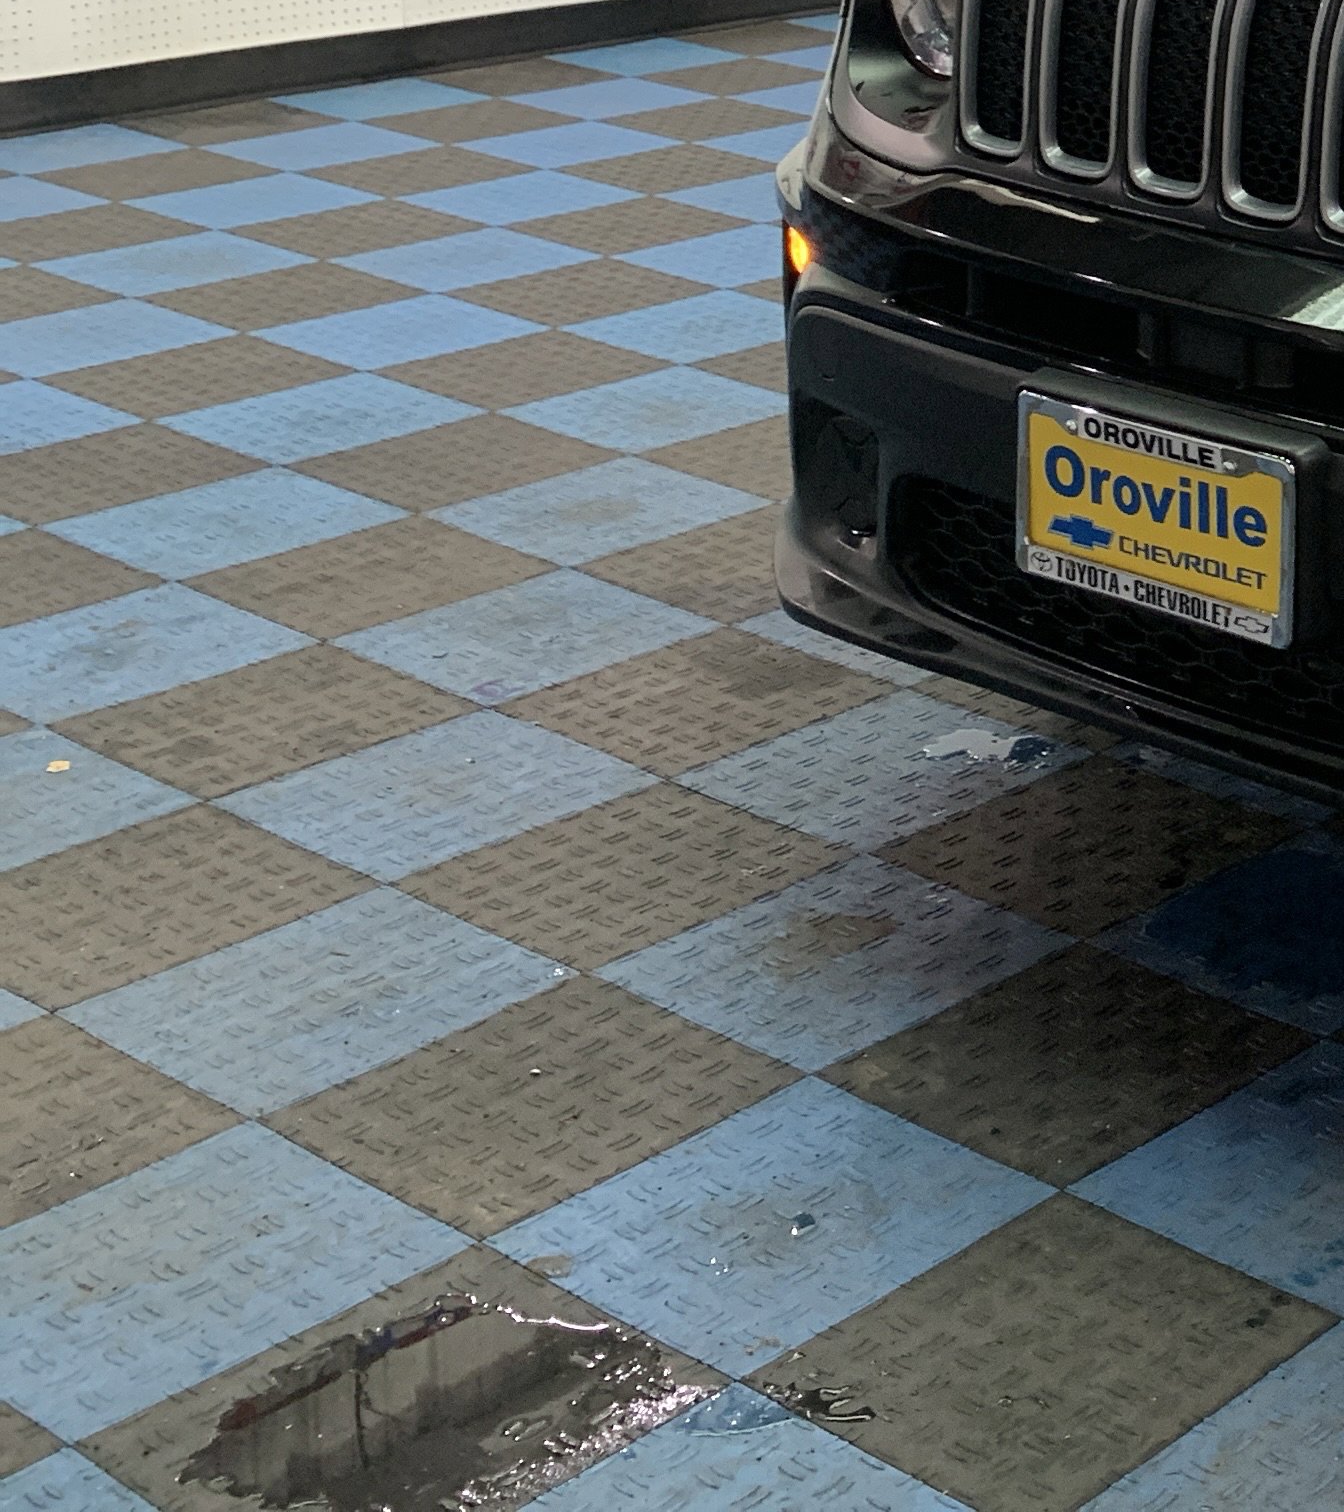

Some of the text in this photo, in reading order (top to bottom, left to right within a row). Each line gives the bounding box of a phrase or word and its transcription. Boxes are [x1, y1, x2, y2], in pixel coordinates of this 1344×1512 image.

[1084, 417, 1215, 469] OROVILLE
[1044, 445, 1267, 547] Oroville
[1056, 555, 1232, 628] TOYOTA CHEVROLET
[1118, 535, 1267, 590] CHEVROLET
